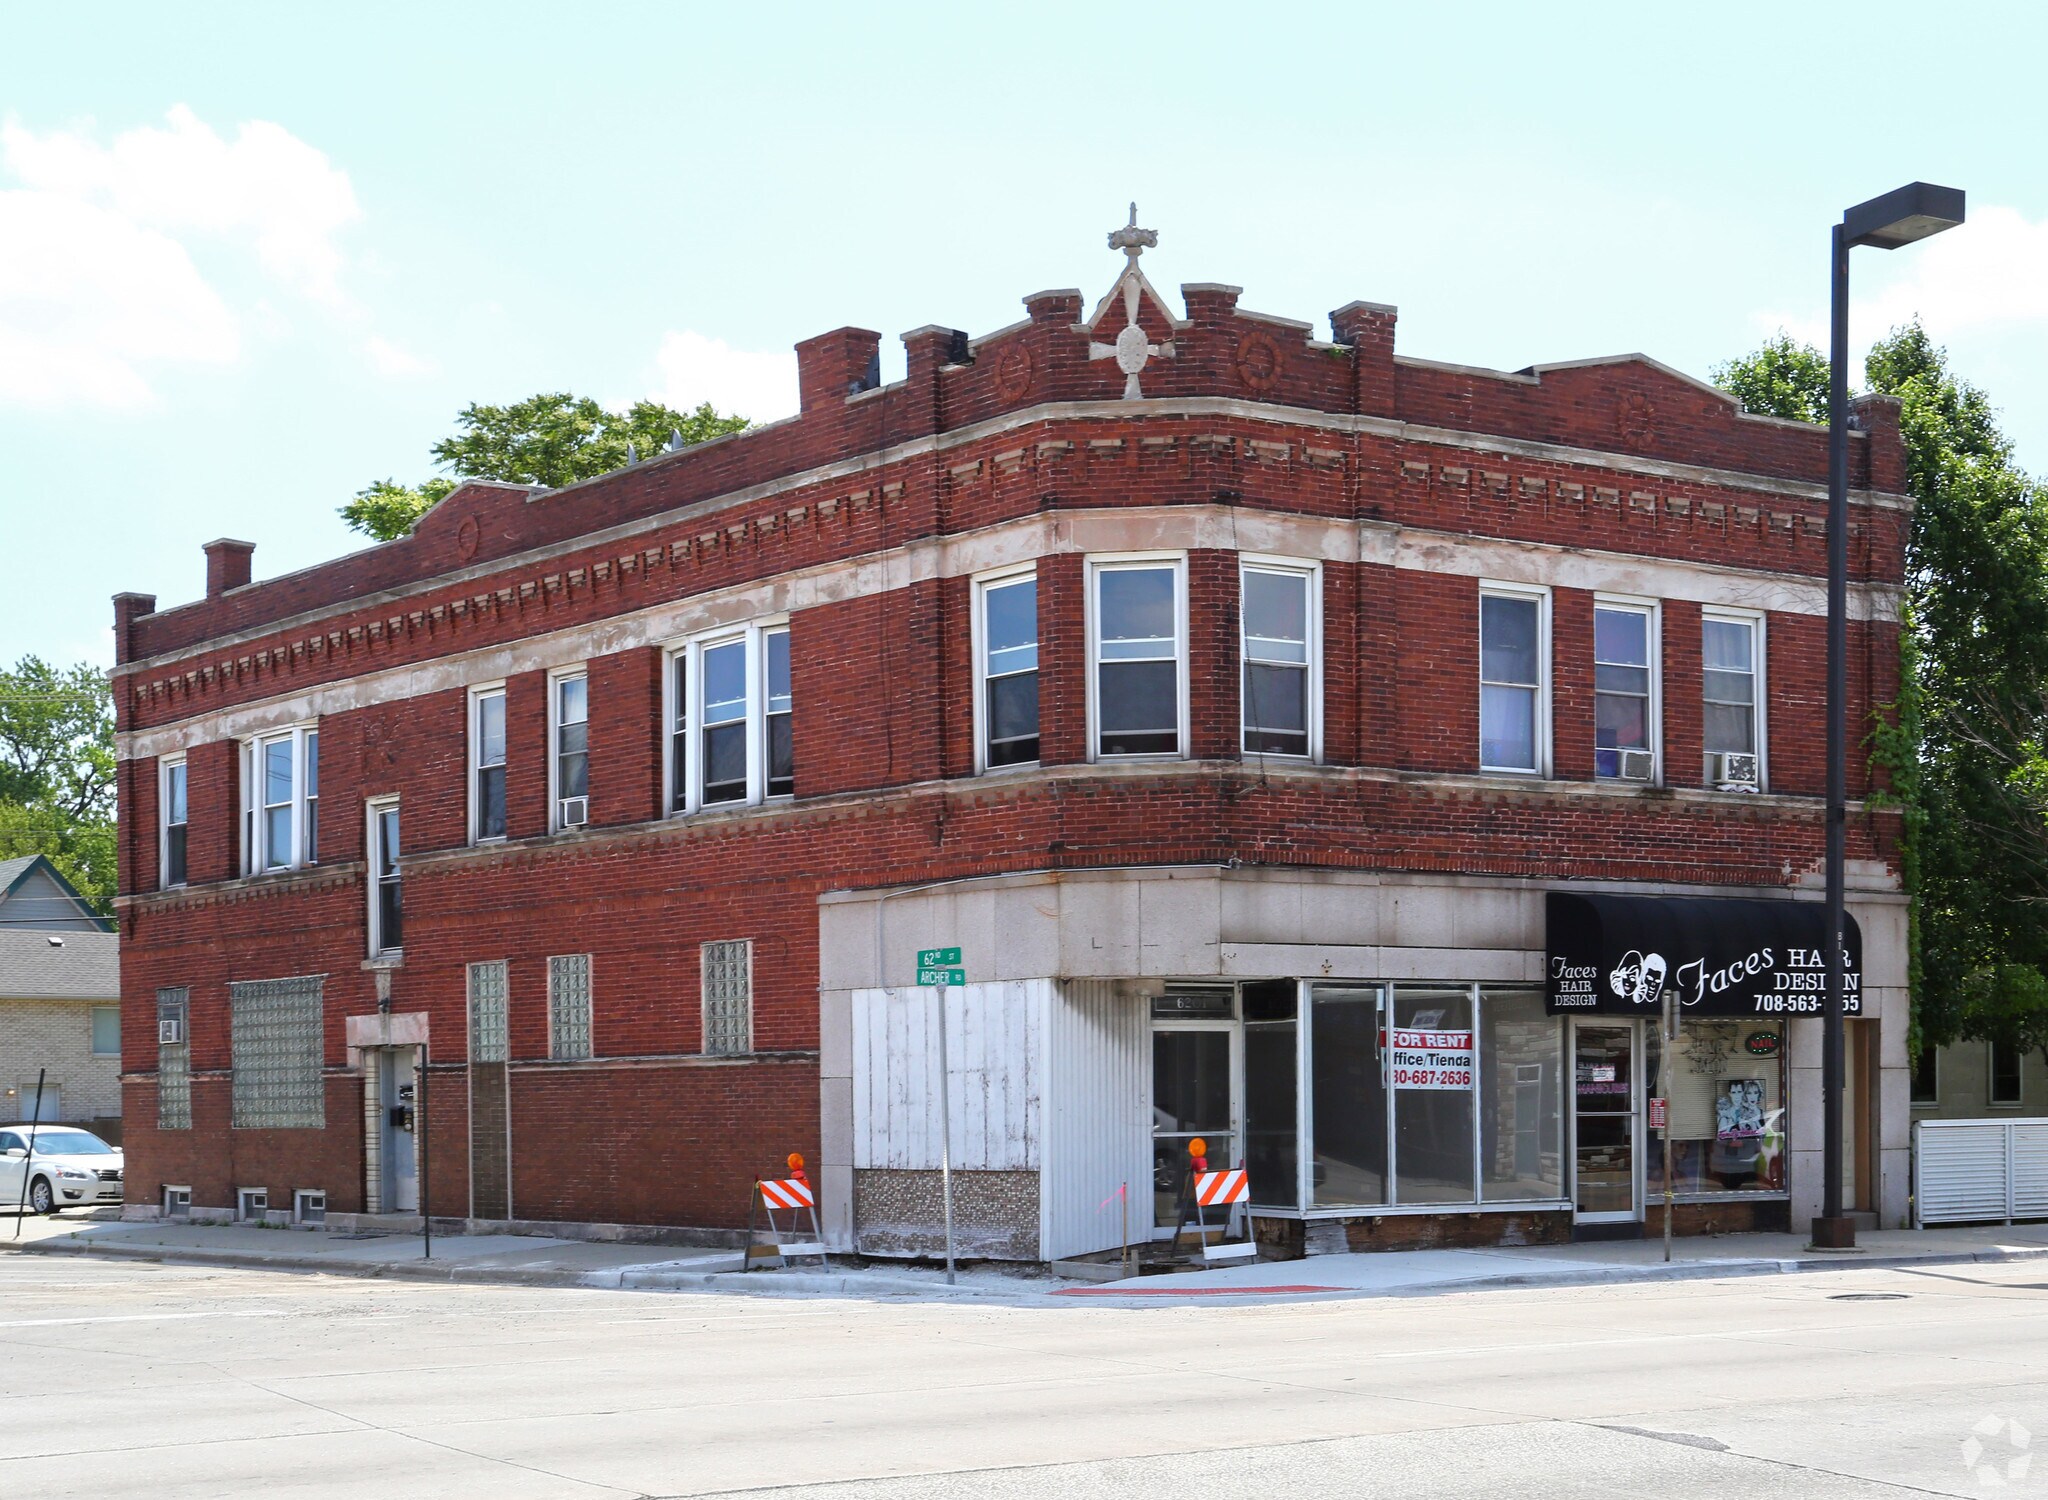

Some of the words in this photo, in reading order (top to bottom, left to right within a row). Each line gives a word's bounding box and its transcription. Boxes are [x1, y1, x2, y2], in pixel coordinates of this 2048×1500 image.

[1787, 948, 1852, 968] HAR
[1551, 956, 1597, 979] Faces
[920, 971, 950, 984] ARCHER
[1676, 947, 1774, 1006] Faces
[1773, 972, 1860, 991] DESIN
[1560, 980, 1592, 993] HAIR
[1177, 997, 1207, 1009] 6201
[1554, 994, 1598, 1006] DESIGN
[1753, 994, 1859, 1012] 708-563-55
[1425, 1034, 1468, 1048] RENT
[1750, 1038, 1776, 1049] NAIL
[1384, 1051, 1470, 1068] ffice/Tienda
[1384, 1069, 1470, 1086] 30-687-2636
